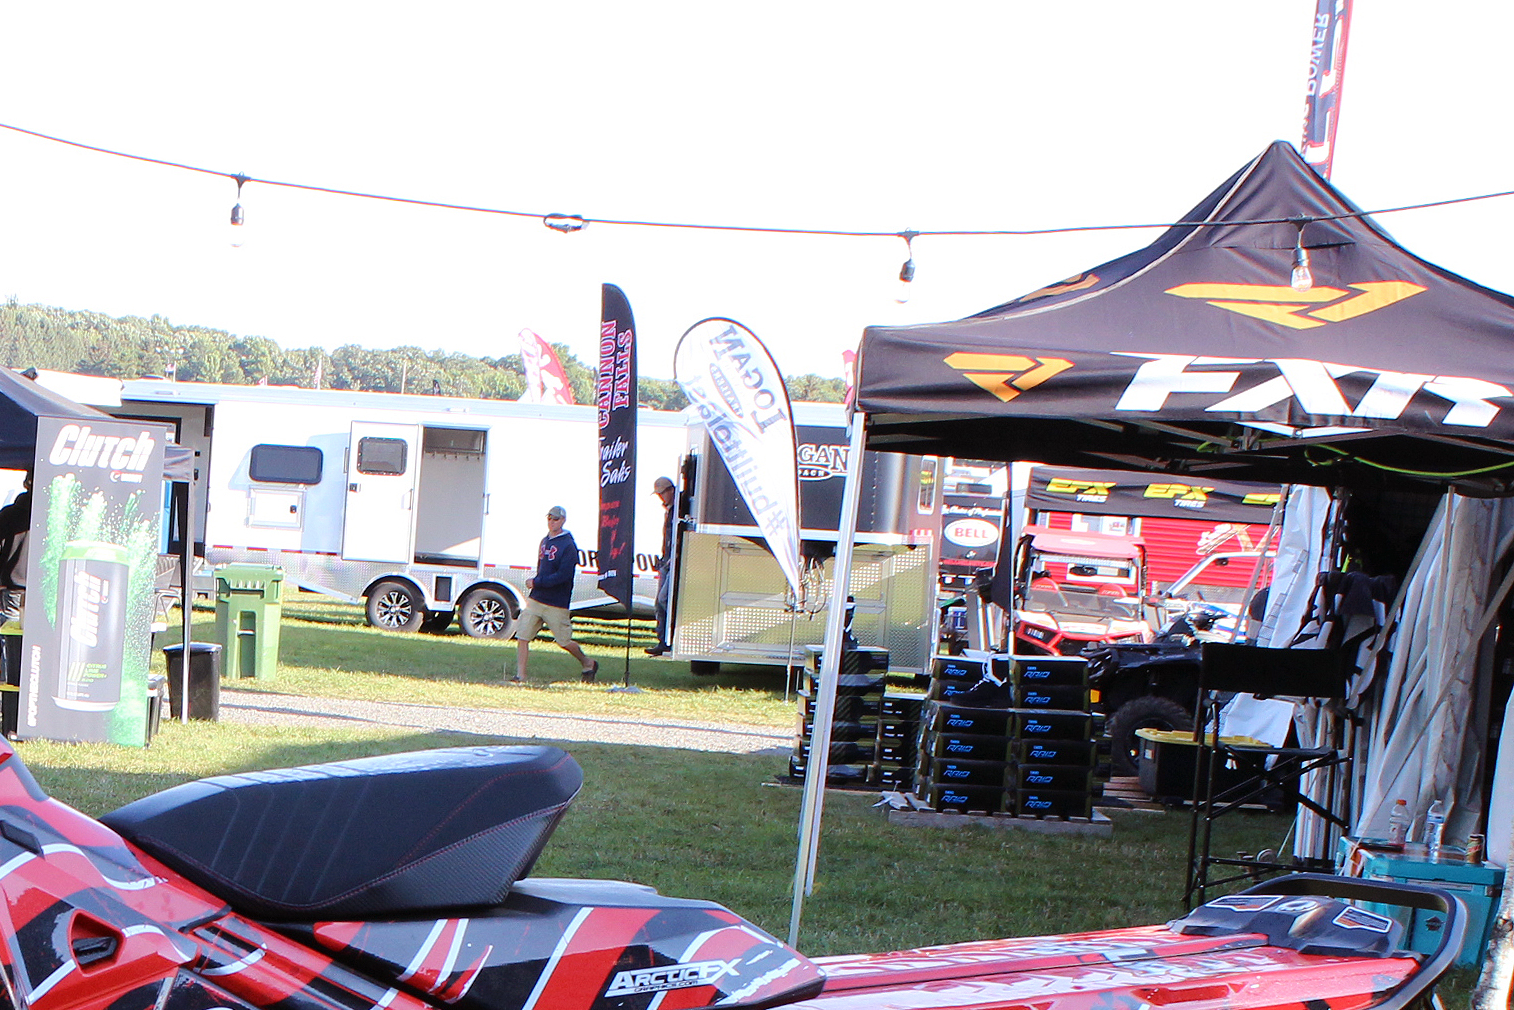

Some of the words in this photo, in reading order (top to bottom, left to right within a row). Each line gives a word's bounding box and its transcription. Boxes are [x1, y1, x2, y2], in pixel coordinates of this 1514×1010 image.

[598, 320, 617, 430] CANNON
[612, 328, 633, 412] FALLS
[48, 423, 156, 472] Clutch
[798, 443, 851, 473] GAN
[1045, 477, 1117, 497] EFX
[1143, 482, 1216, 500] EFX
[1075, 493, 1109, 503] TIRES
[1173, 498, 1206, 508] TIRES
[954, 527, 989, 539] BELL
